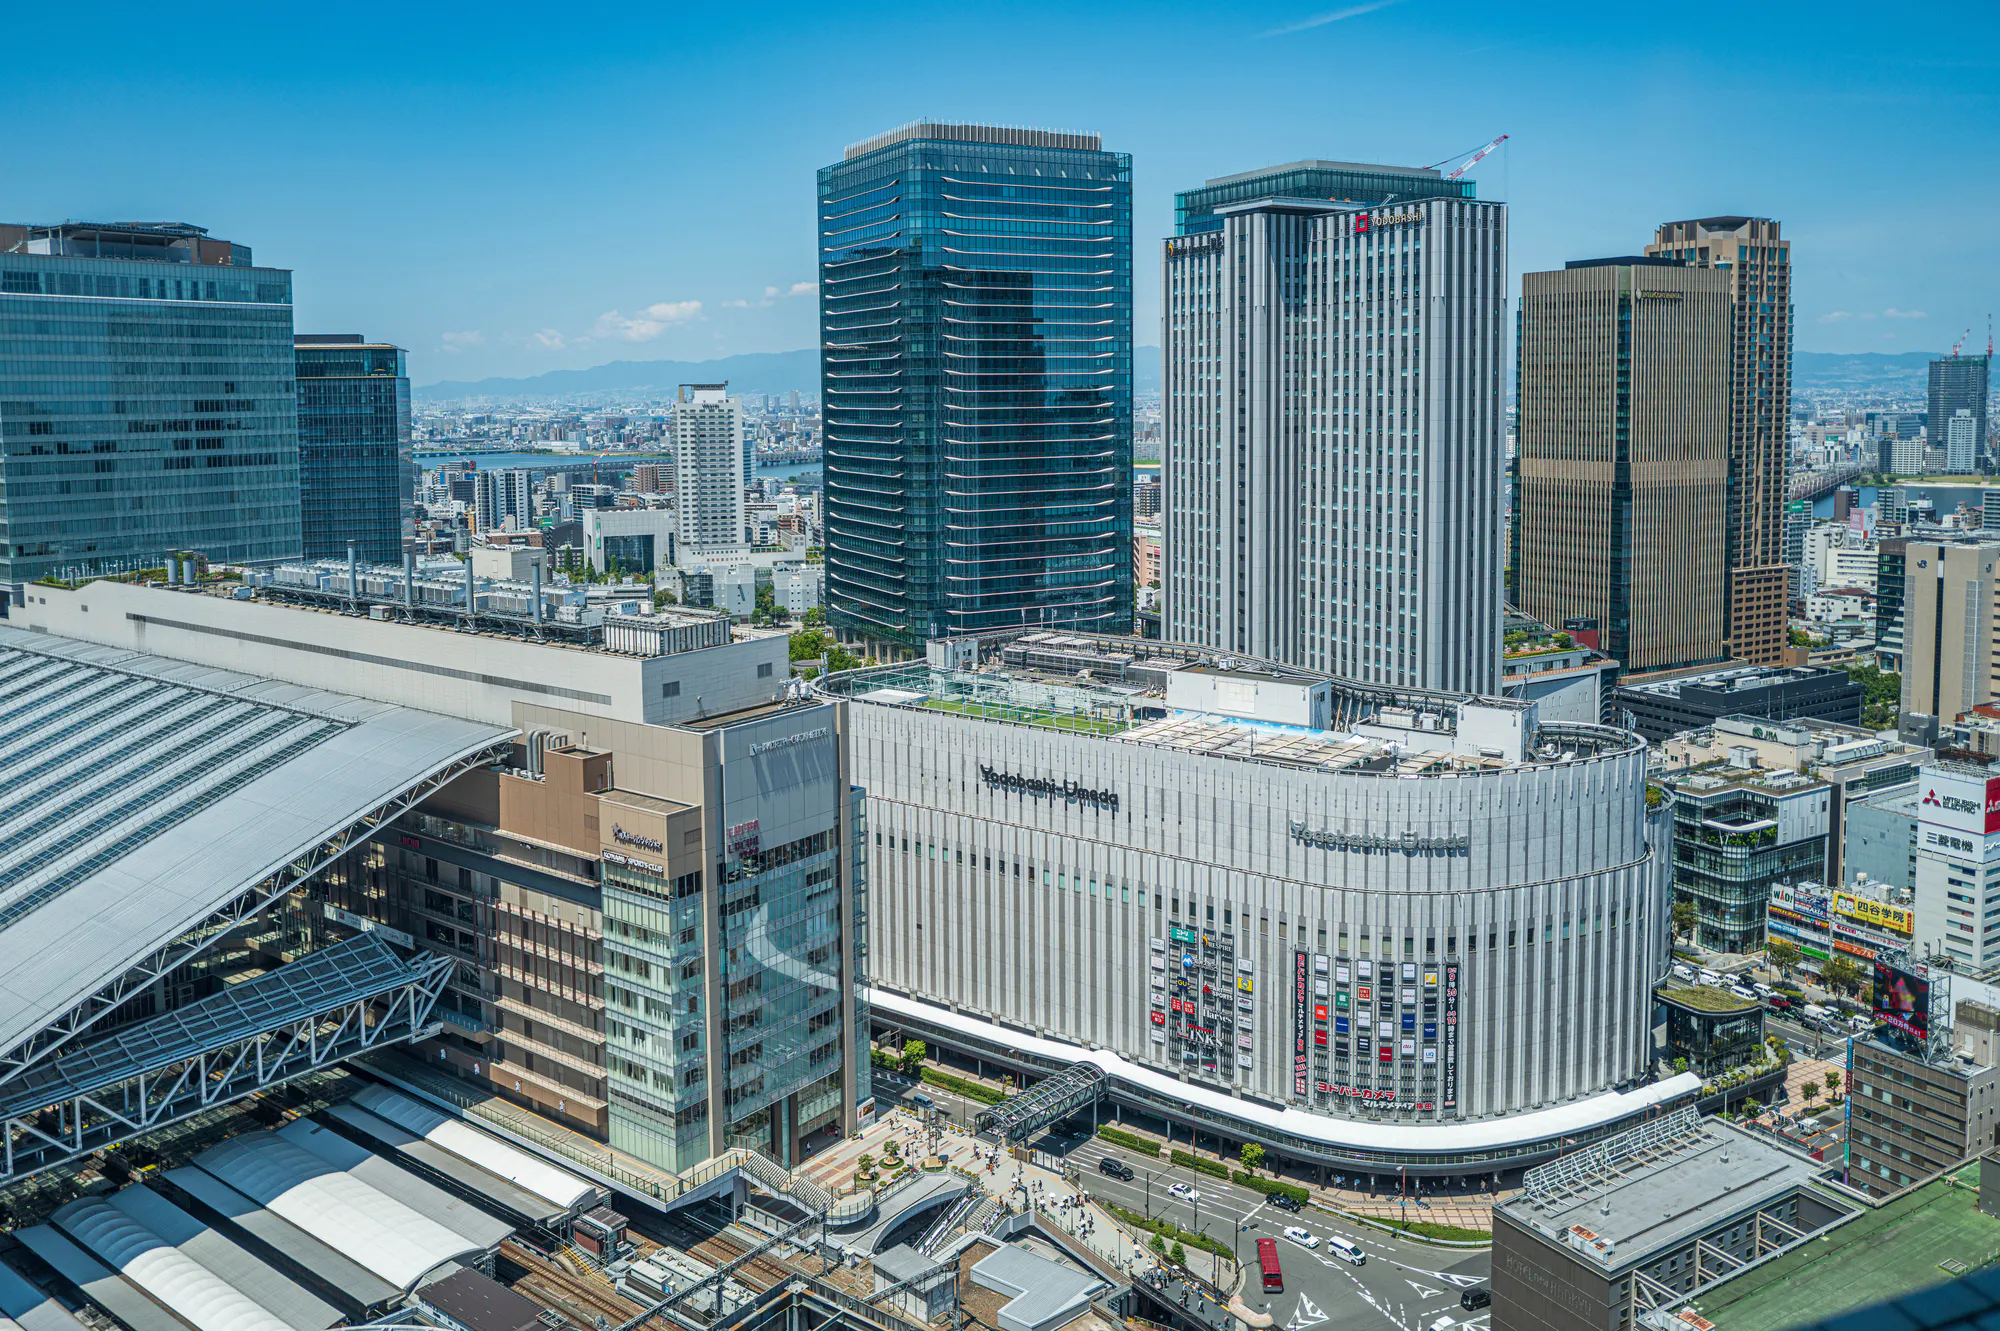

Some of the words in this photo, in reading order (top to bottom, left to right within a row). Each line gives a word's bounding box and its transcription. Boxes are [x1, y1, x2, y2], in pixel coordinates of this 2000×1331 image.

[1371, 212, 1422, 226] YODOBASHI
[1917, 560, 1927, 568] JR
[980, 764, 1119, 805] Yodobashi-Umeda
[1943, 795, 1981, 810] MITSUBISHI
[1943, 801, 1976, 814] ELECTRIC
[1290, 819, 1468, 849] Yodobashi-Umeda
[1926, 831, 1973, 853] 三菱電機
[603, 851, 625, 862] KONAMI
[628, 857, 648, 868] SPORTS
[648, 863, 663, 872] CLUB
[1858, 901, 1904, 923] 四谷学院
[1177, 979, 1187, 987] GU
[1317, 1081, 1395, 1100] ヨドバシカメラ
[1506, 1254, 1532, 1282] HOTEL
